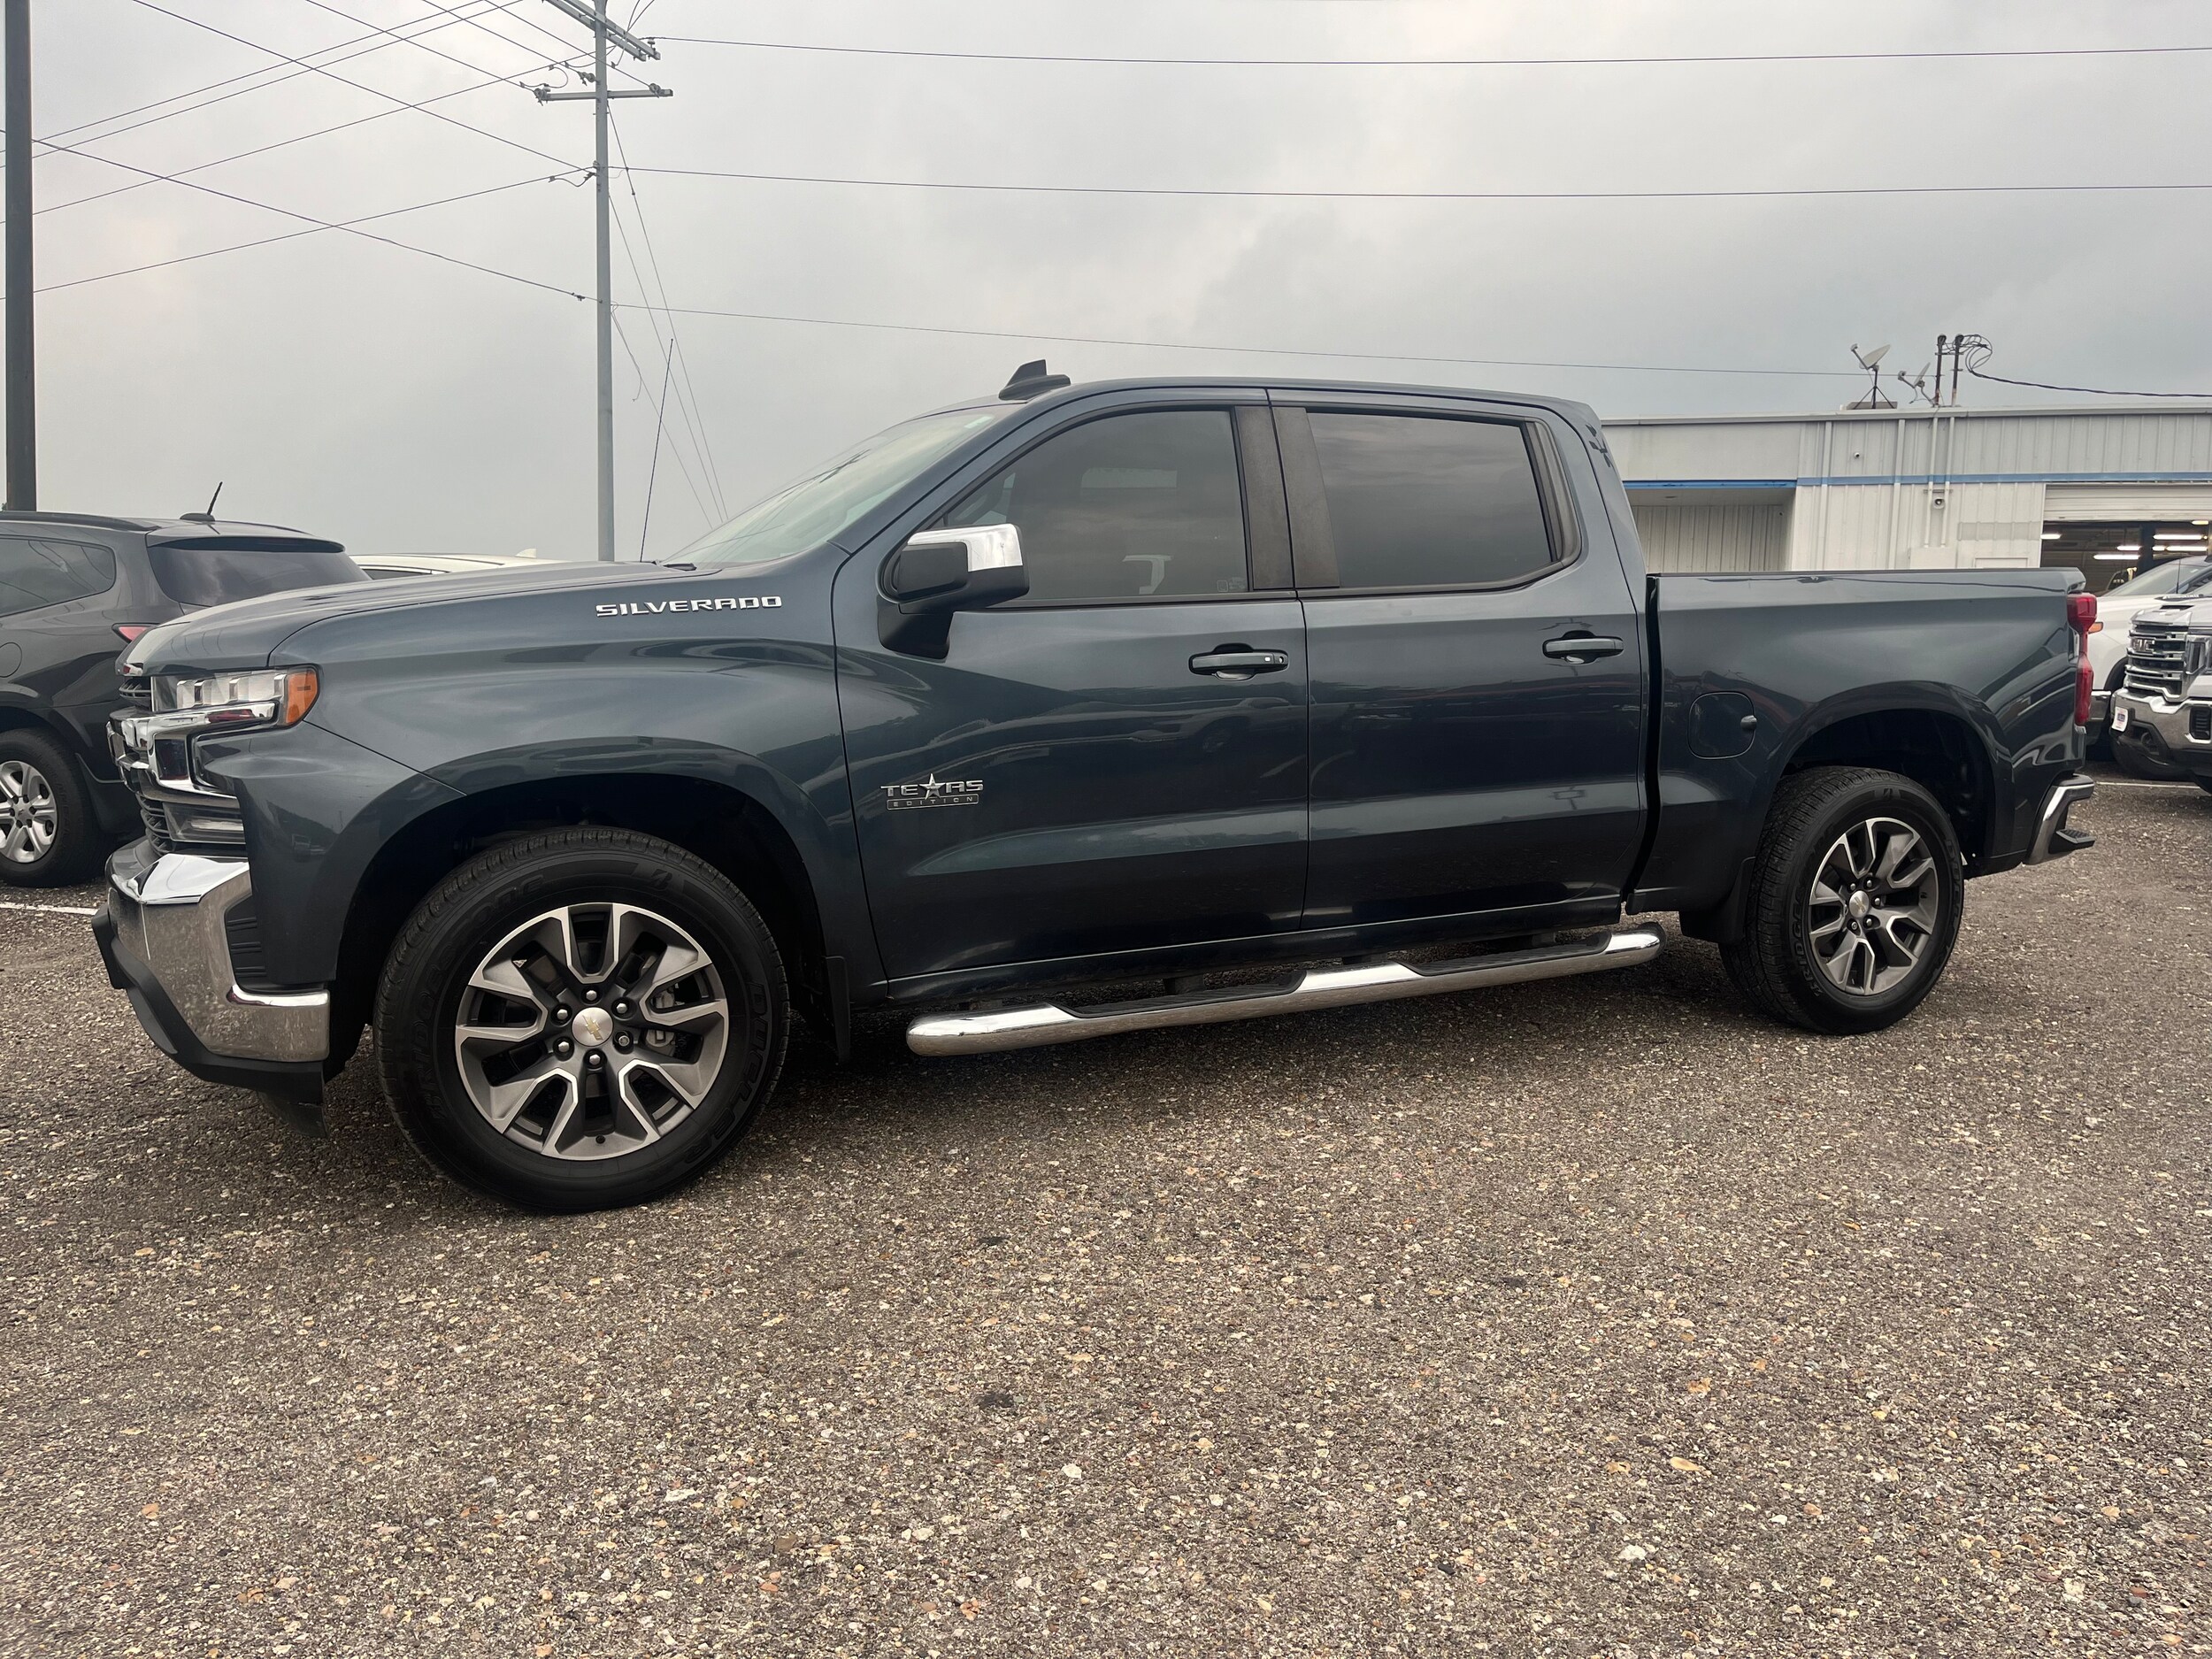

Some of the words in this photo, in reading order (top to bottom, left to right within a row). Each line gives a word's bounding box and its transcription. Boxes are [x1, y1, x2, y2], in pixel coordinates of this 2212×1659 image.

[595, 595, 783, 618] SILVERADO
[880, 775, 984, 798] TEXAS
[893, 796, 973, 807] EDITION
[684, 982, 769, 1164] DUELER
